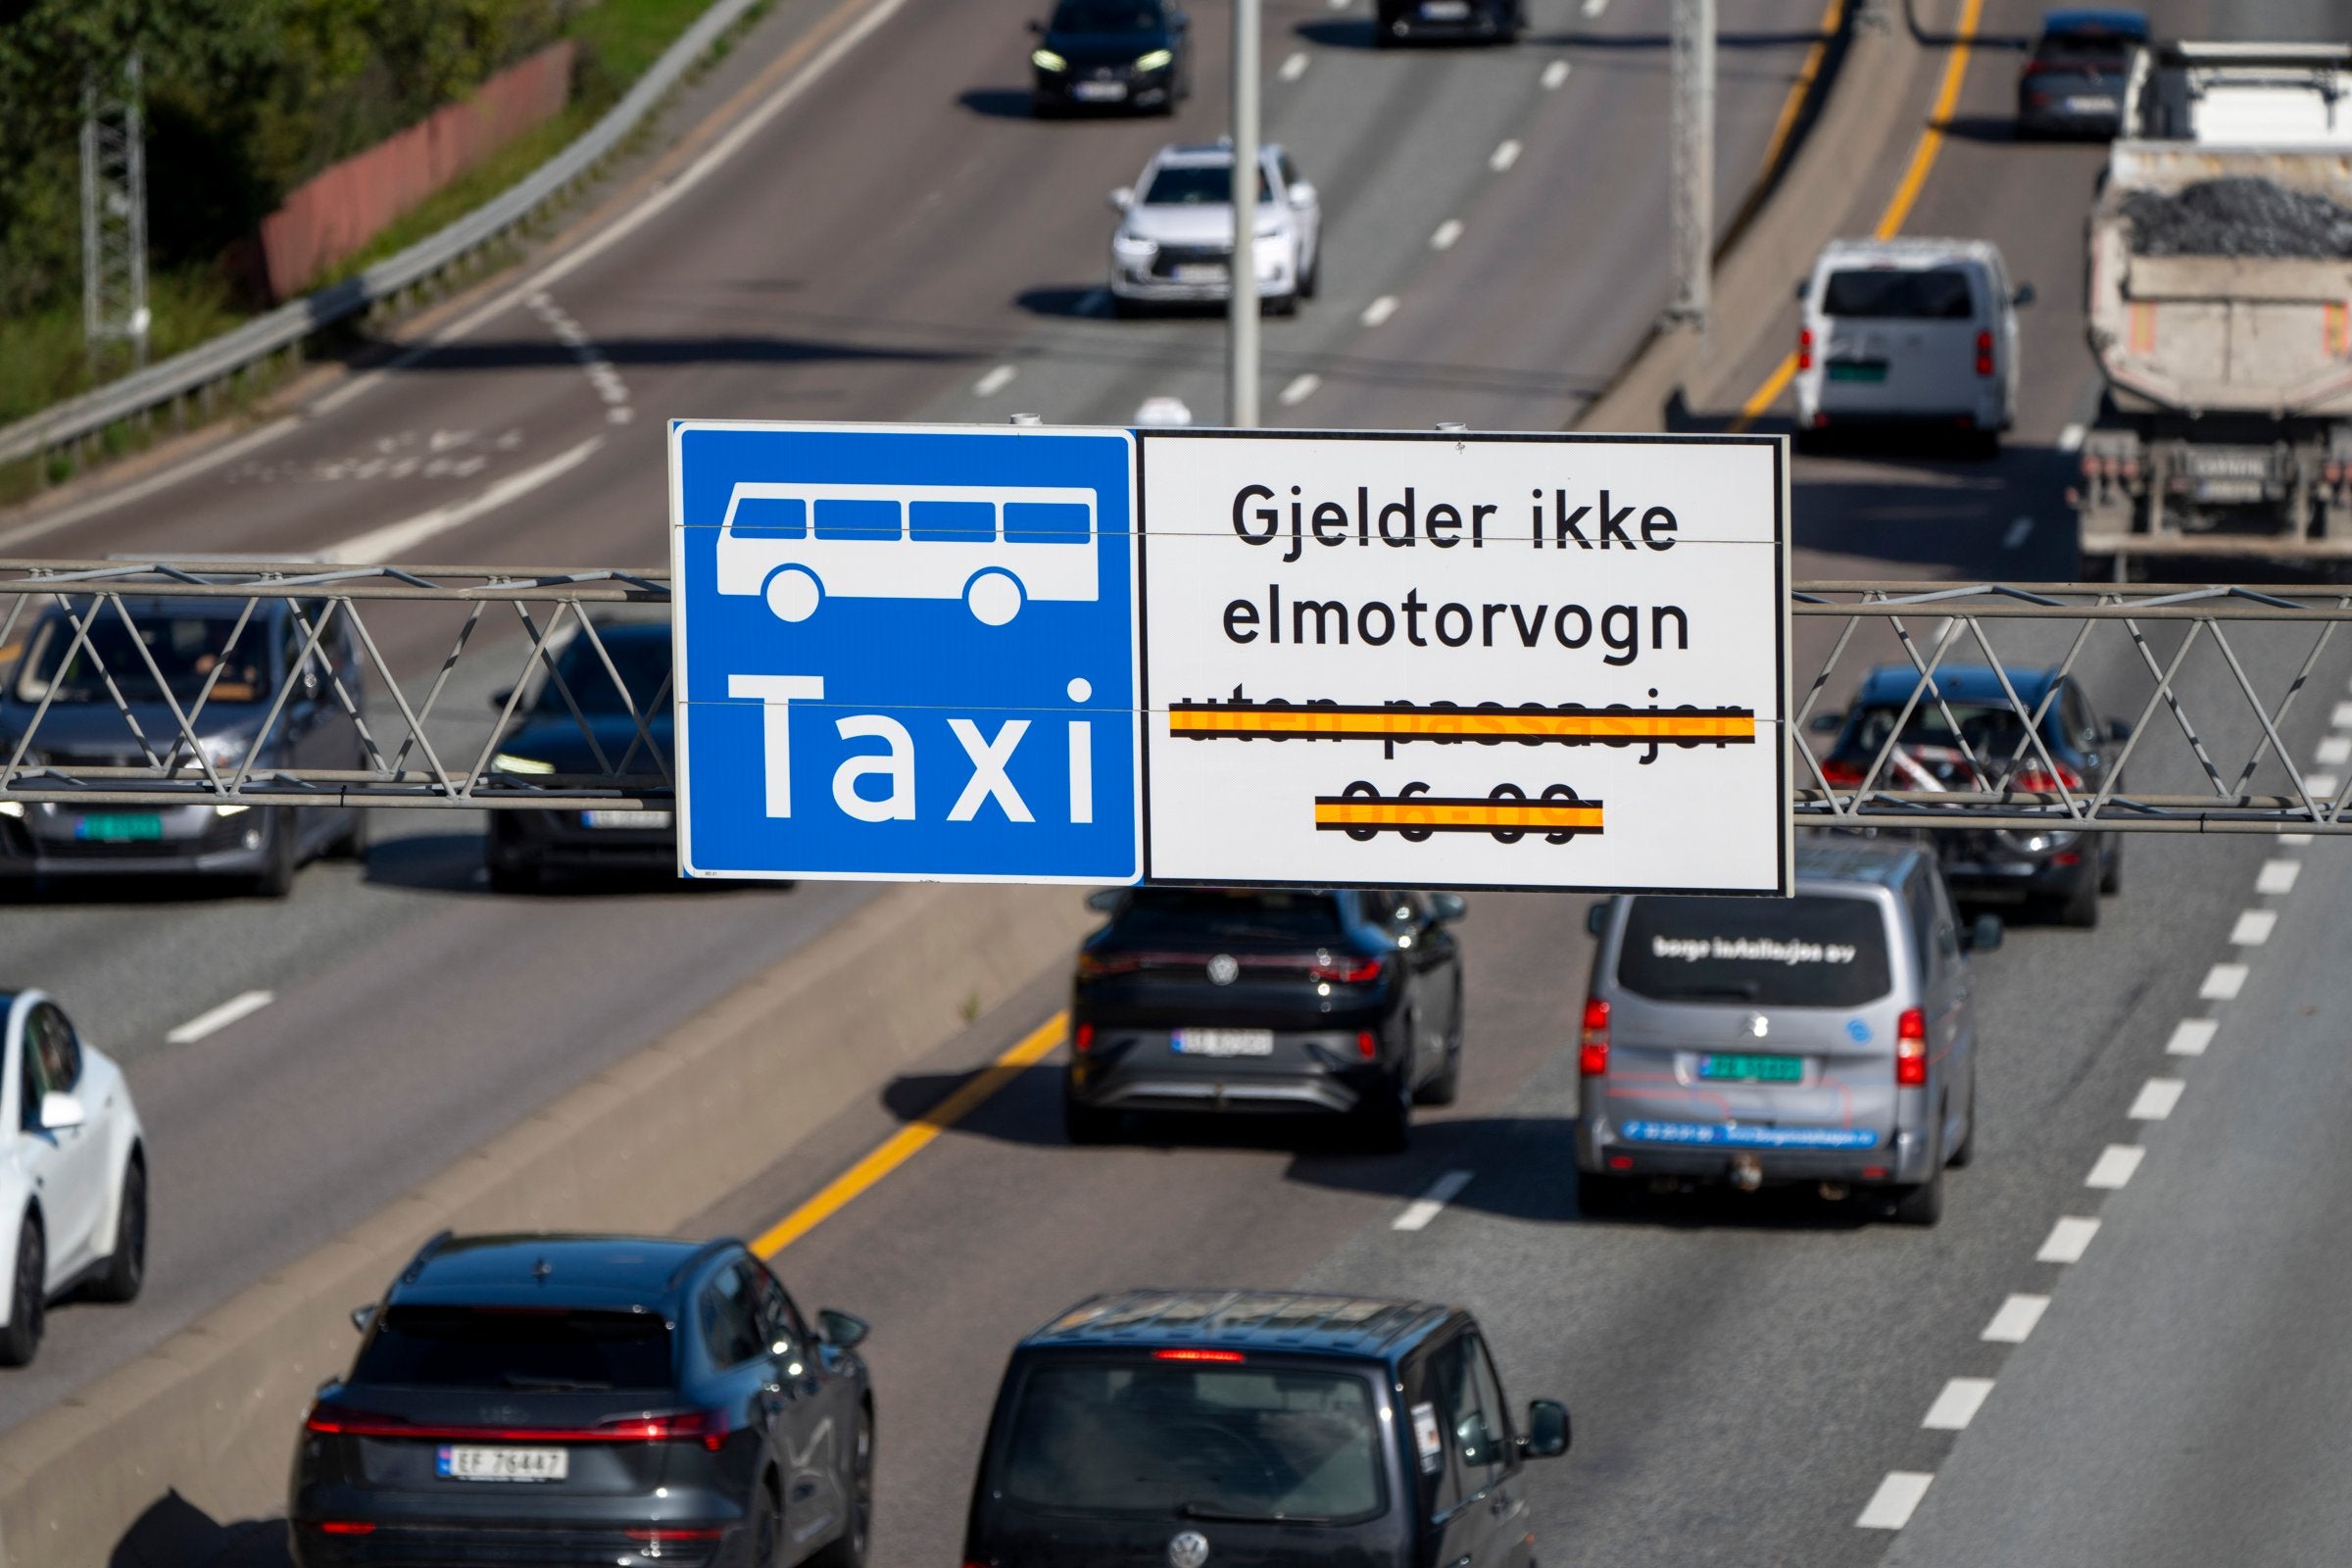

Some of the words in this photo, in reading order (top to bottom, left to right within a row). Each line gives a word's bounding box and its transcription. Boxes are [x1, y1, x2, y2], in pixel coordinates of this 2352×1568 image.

[1232, 485, 1498, 564] Gjelder
[1532, 488, 1679, 552] ikke
[1223, 583, 1690, 666] elmotorvogn
[727, 674, 1094, 824] Taxi
